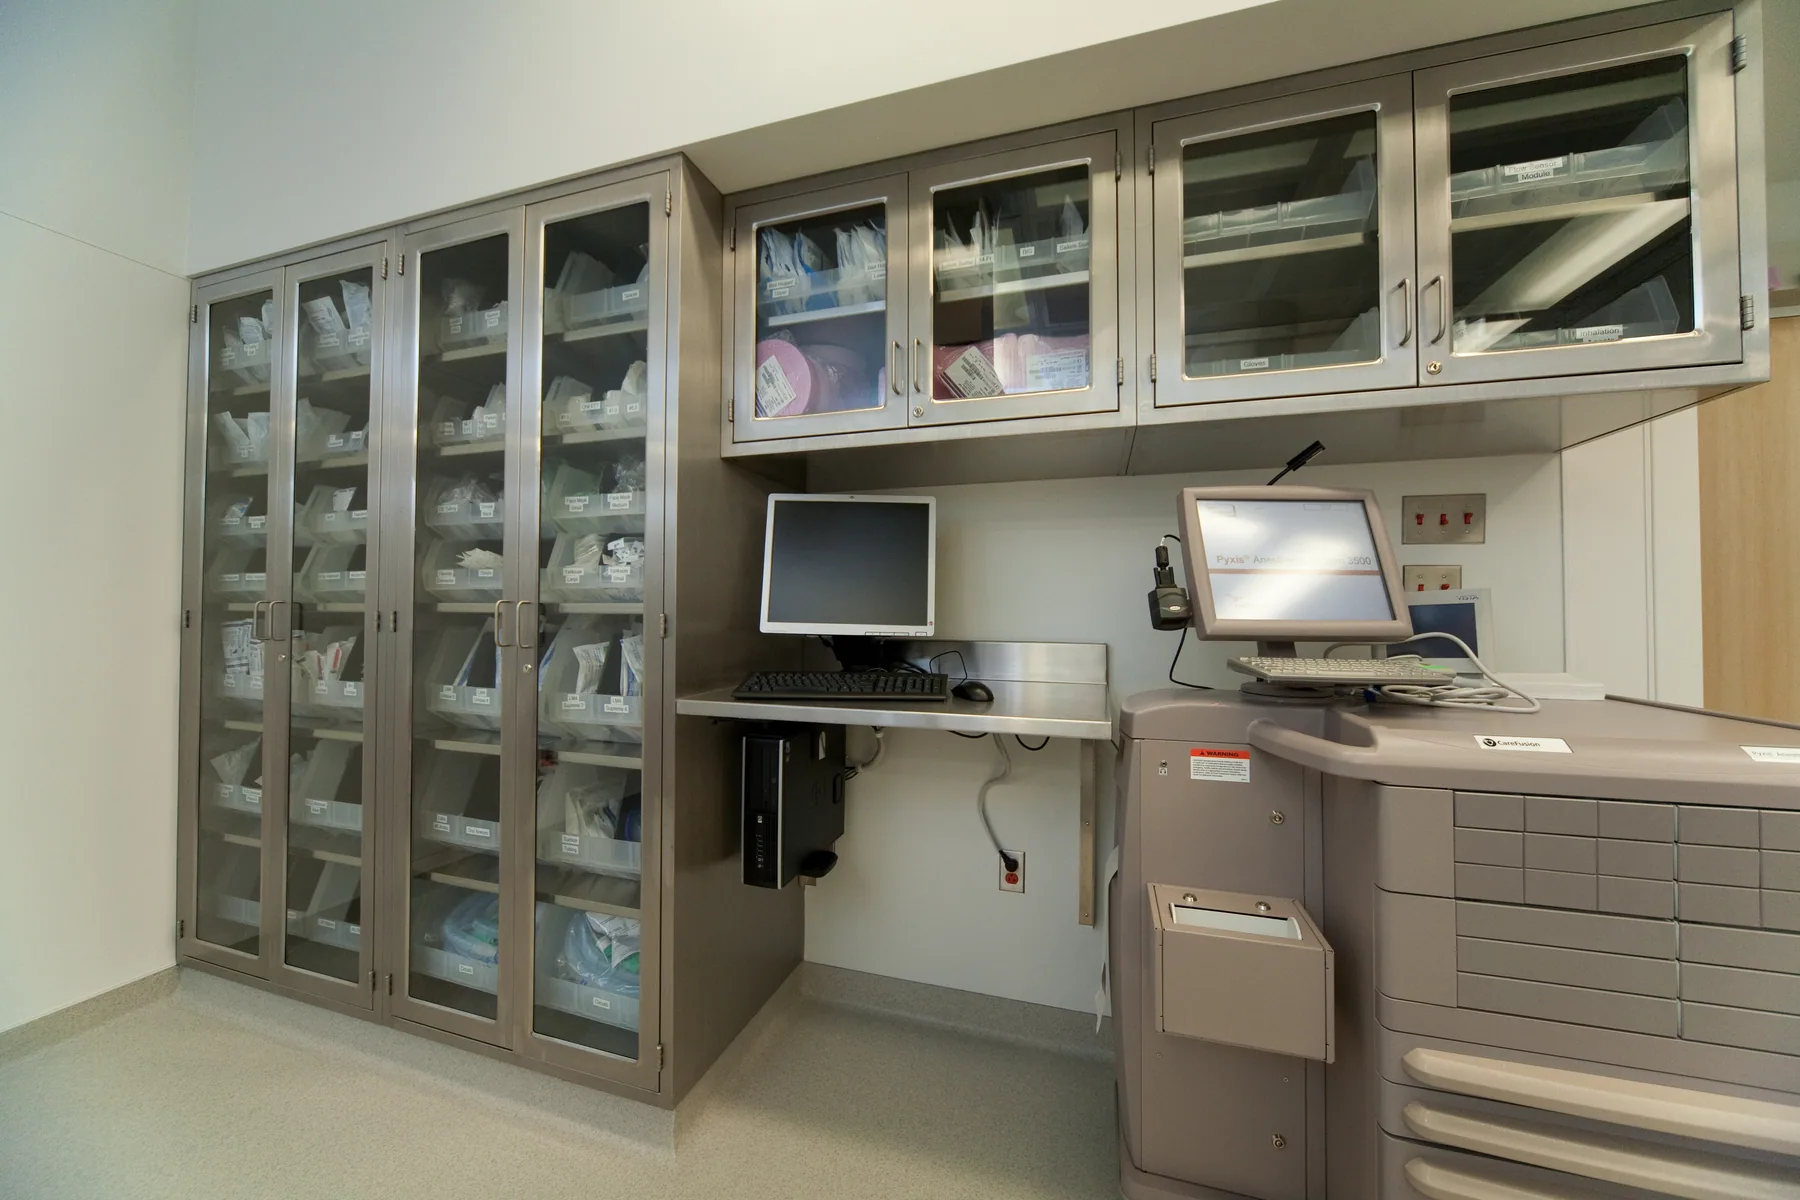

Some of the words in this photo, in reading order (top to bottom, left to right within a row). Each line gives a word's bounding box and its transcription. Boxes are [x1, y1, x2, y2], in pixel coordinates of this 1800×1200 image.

[1529, 160, 1557, 170] Sensor
[1521, 170, 1550, 180] Module
[1580, 328, 1620, 337] Inhalation
[1243, 360, 1266, 368] Gloves
[1347, 556, 1372, 566] 3500
[1497, 739, 1541, 748] CareFusion
